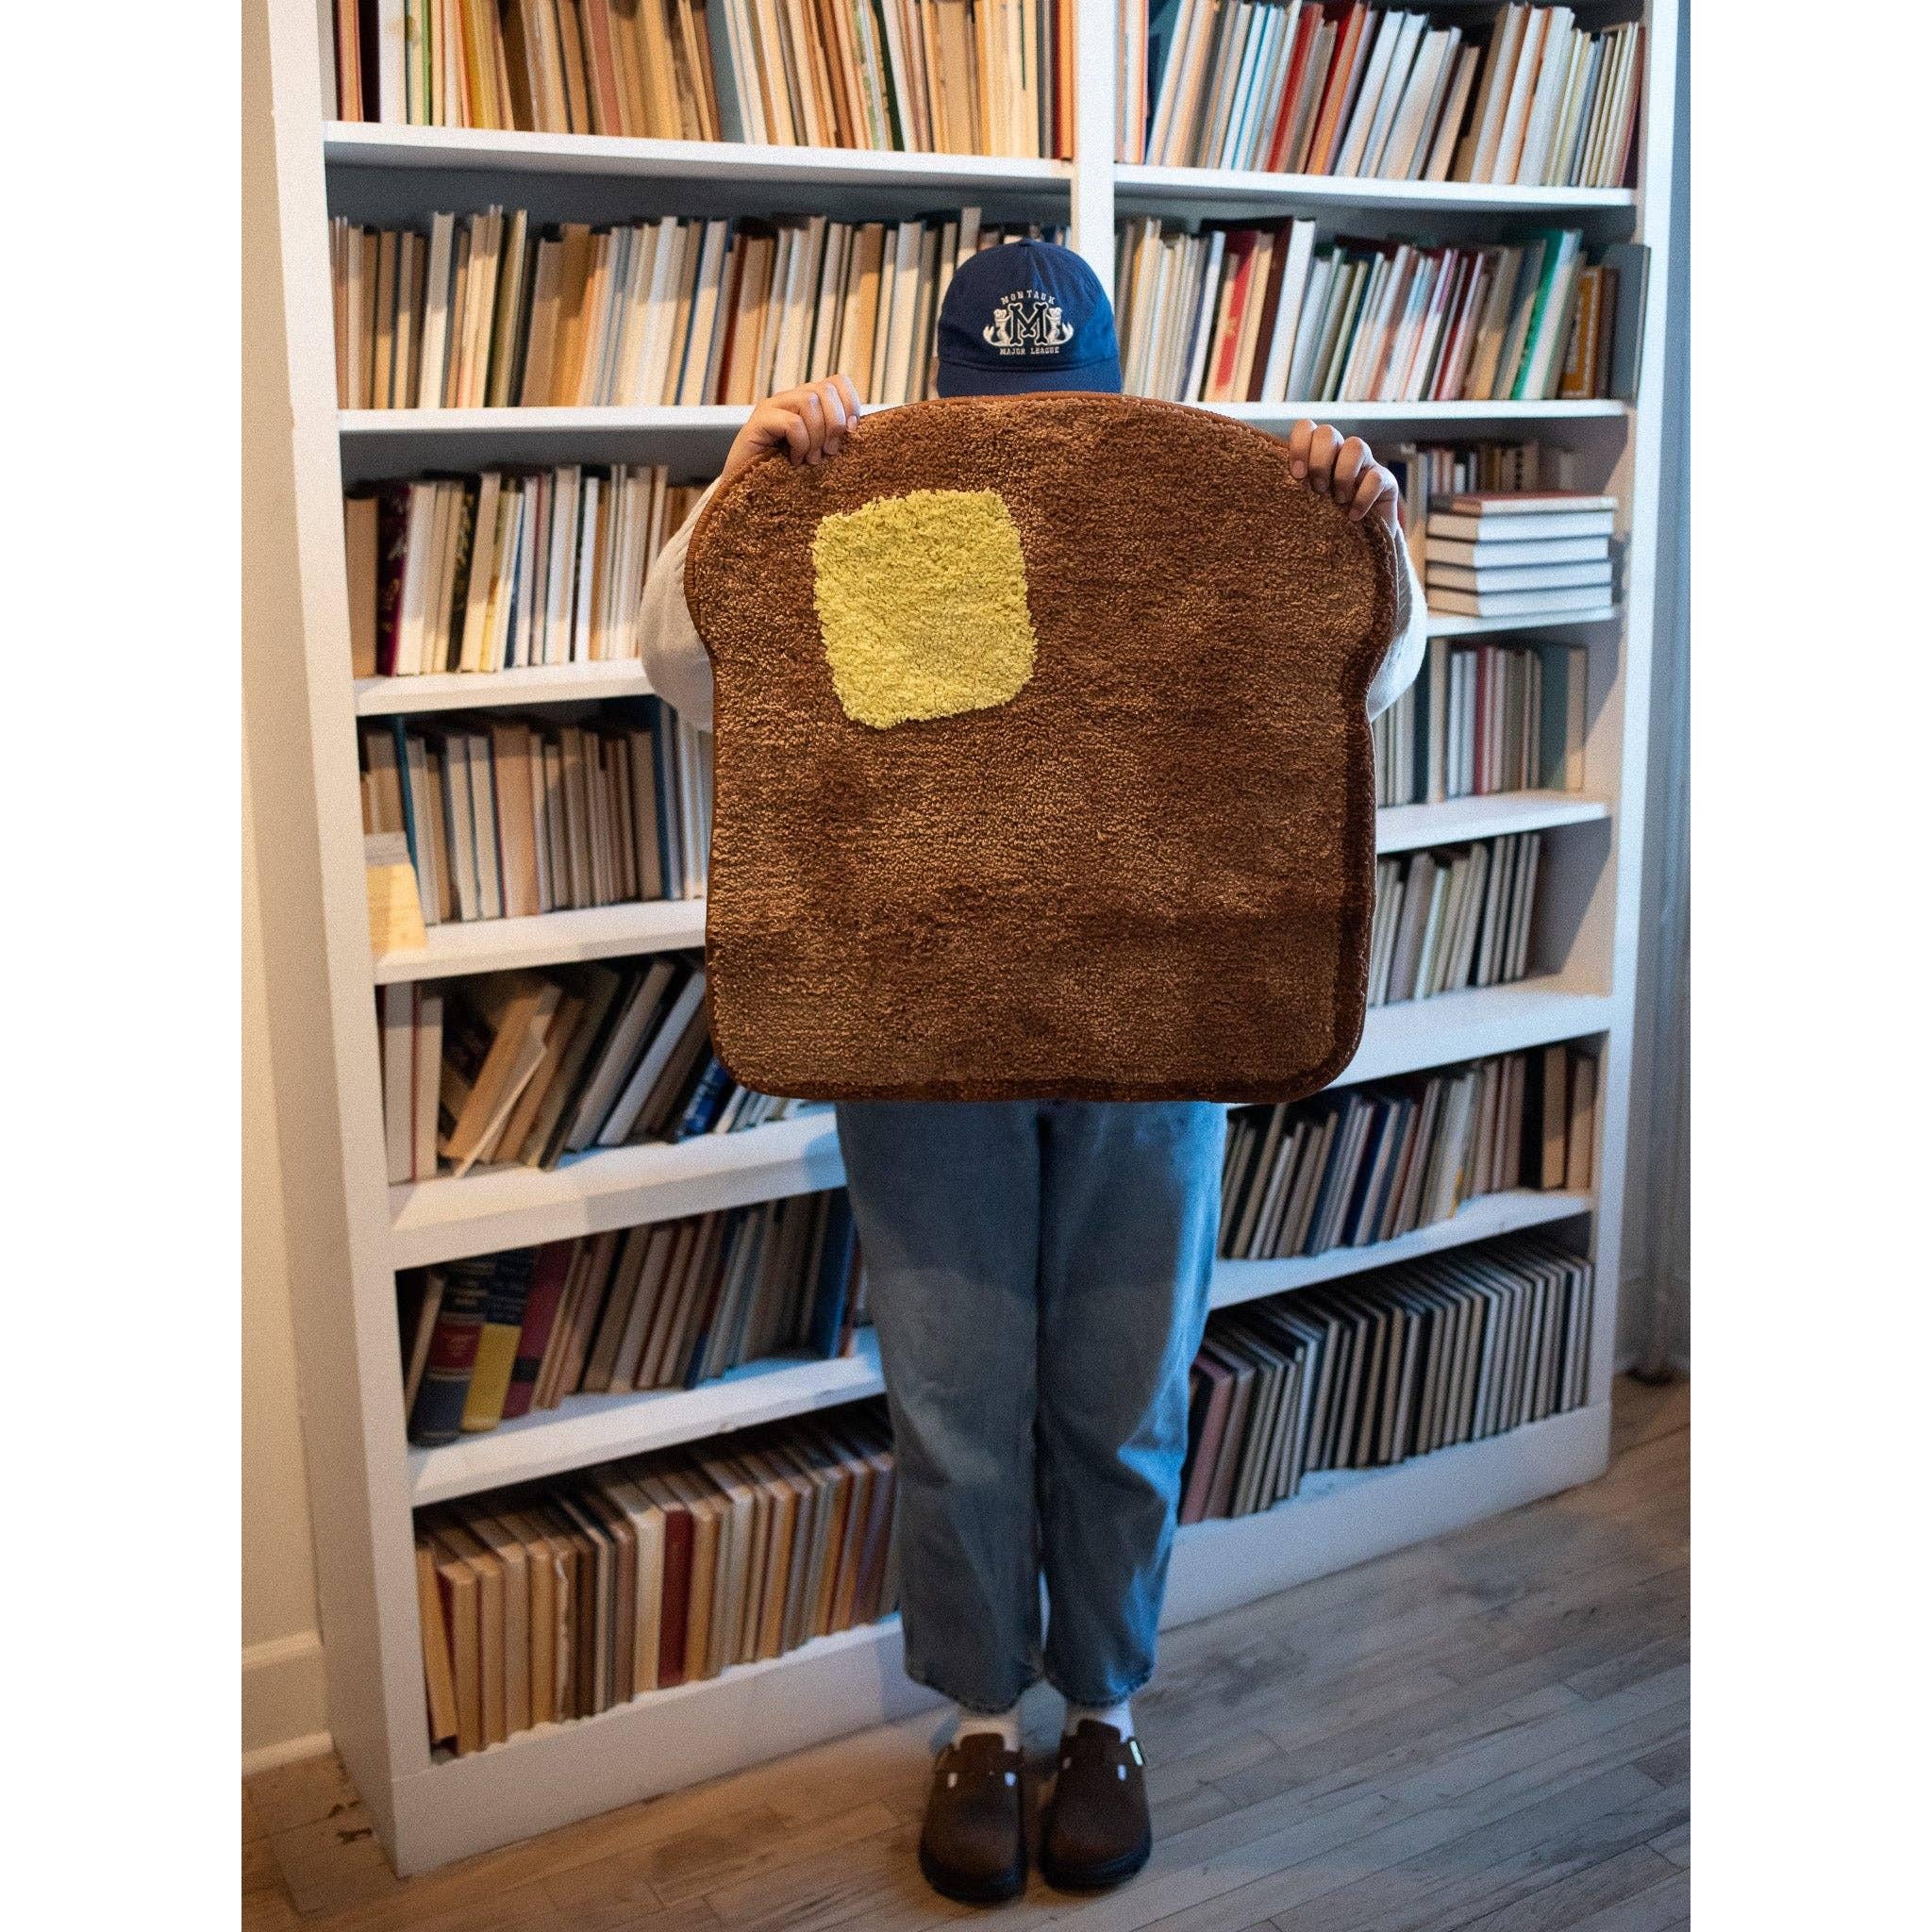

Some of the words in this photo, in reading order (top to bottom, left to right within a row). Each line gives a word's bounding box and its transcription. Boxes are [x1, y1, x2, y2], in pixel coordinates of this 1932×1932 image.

[1000, 290, 1056, 305] MONTAUK
[1008, 302, 1048, 346] M
[1000, 347, 1025, 356] MAJOR
[1030, 346, 1059, 355] LEAGUE
